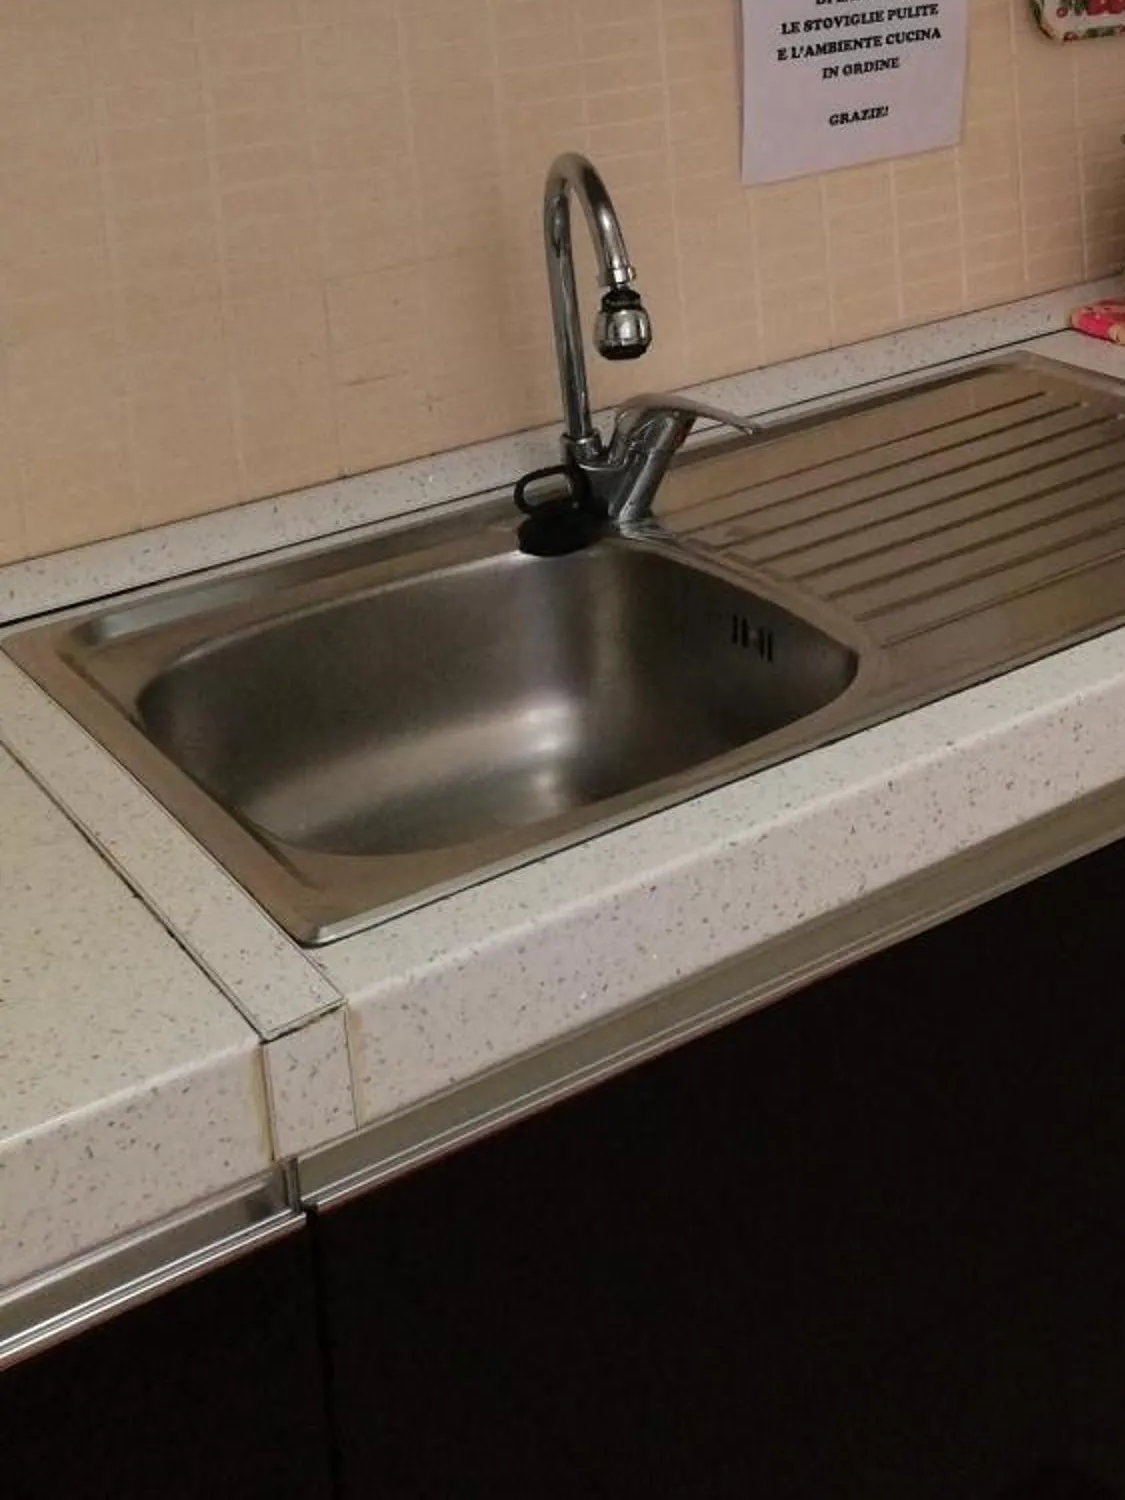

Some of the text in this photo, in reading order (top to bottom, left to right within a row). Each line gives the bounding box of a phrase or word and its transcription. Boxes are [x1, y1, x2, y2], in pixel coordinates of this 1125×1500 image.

[781, 3, 939, 35] LE STOVIGLIE PULITE
[777, 28, 942, 61] E L'AMBIENTE CUCINA
[821, 57, 900, 79] IN ORDINE
[828, 106, 889, 127] GRAZIE!
